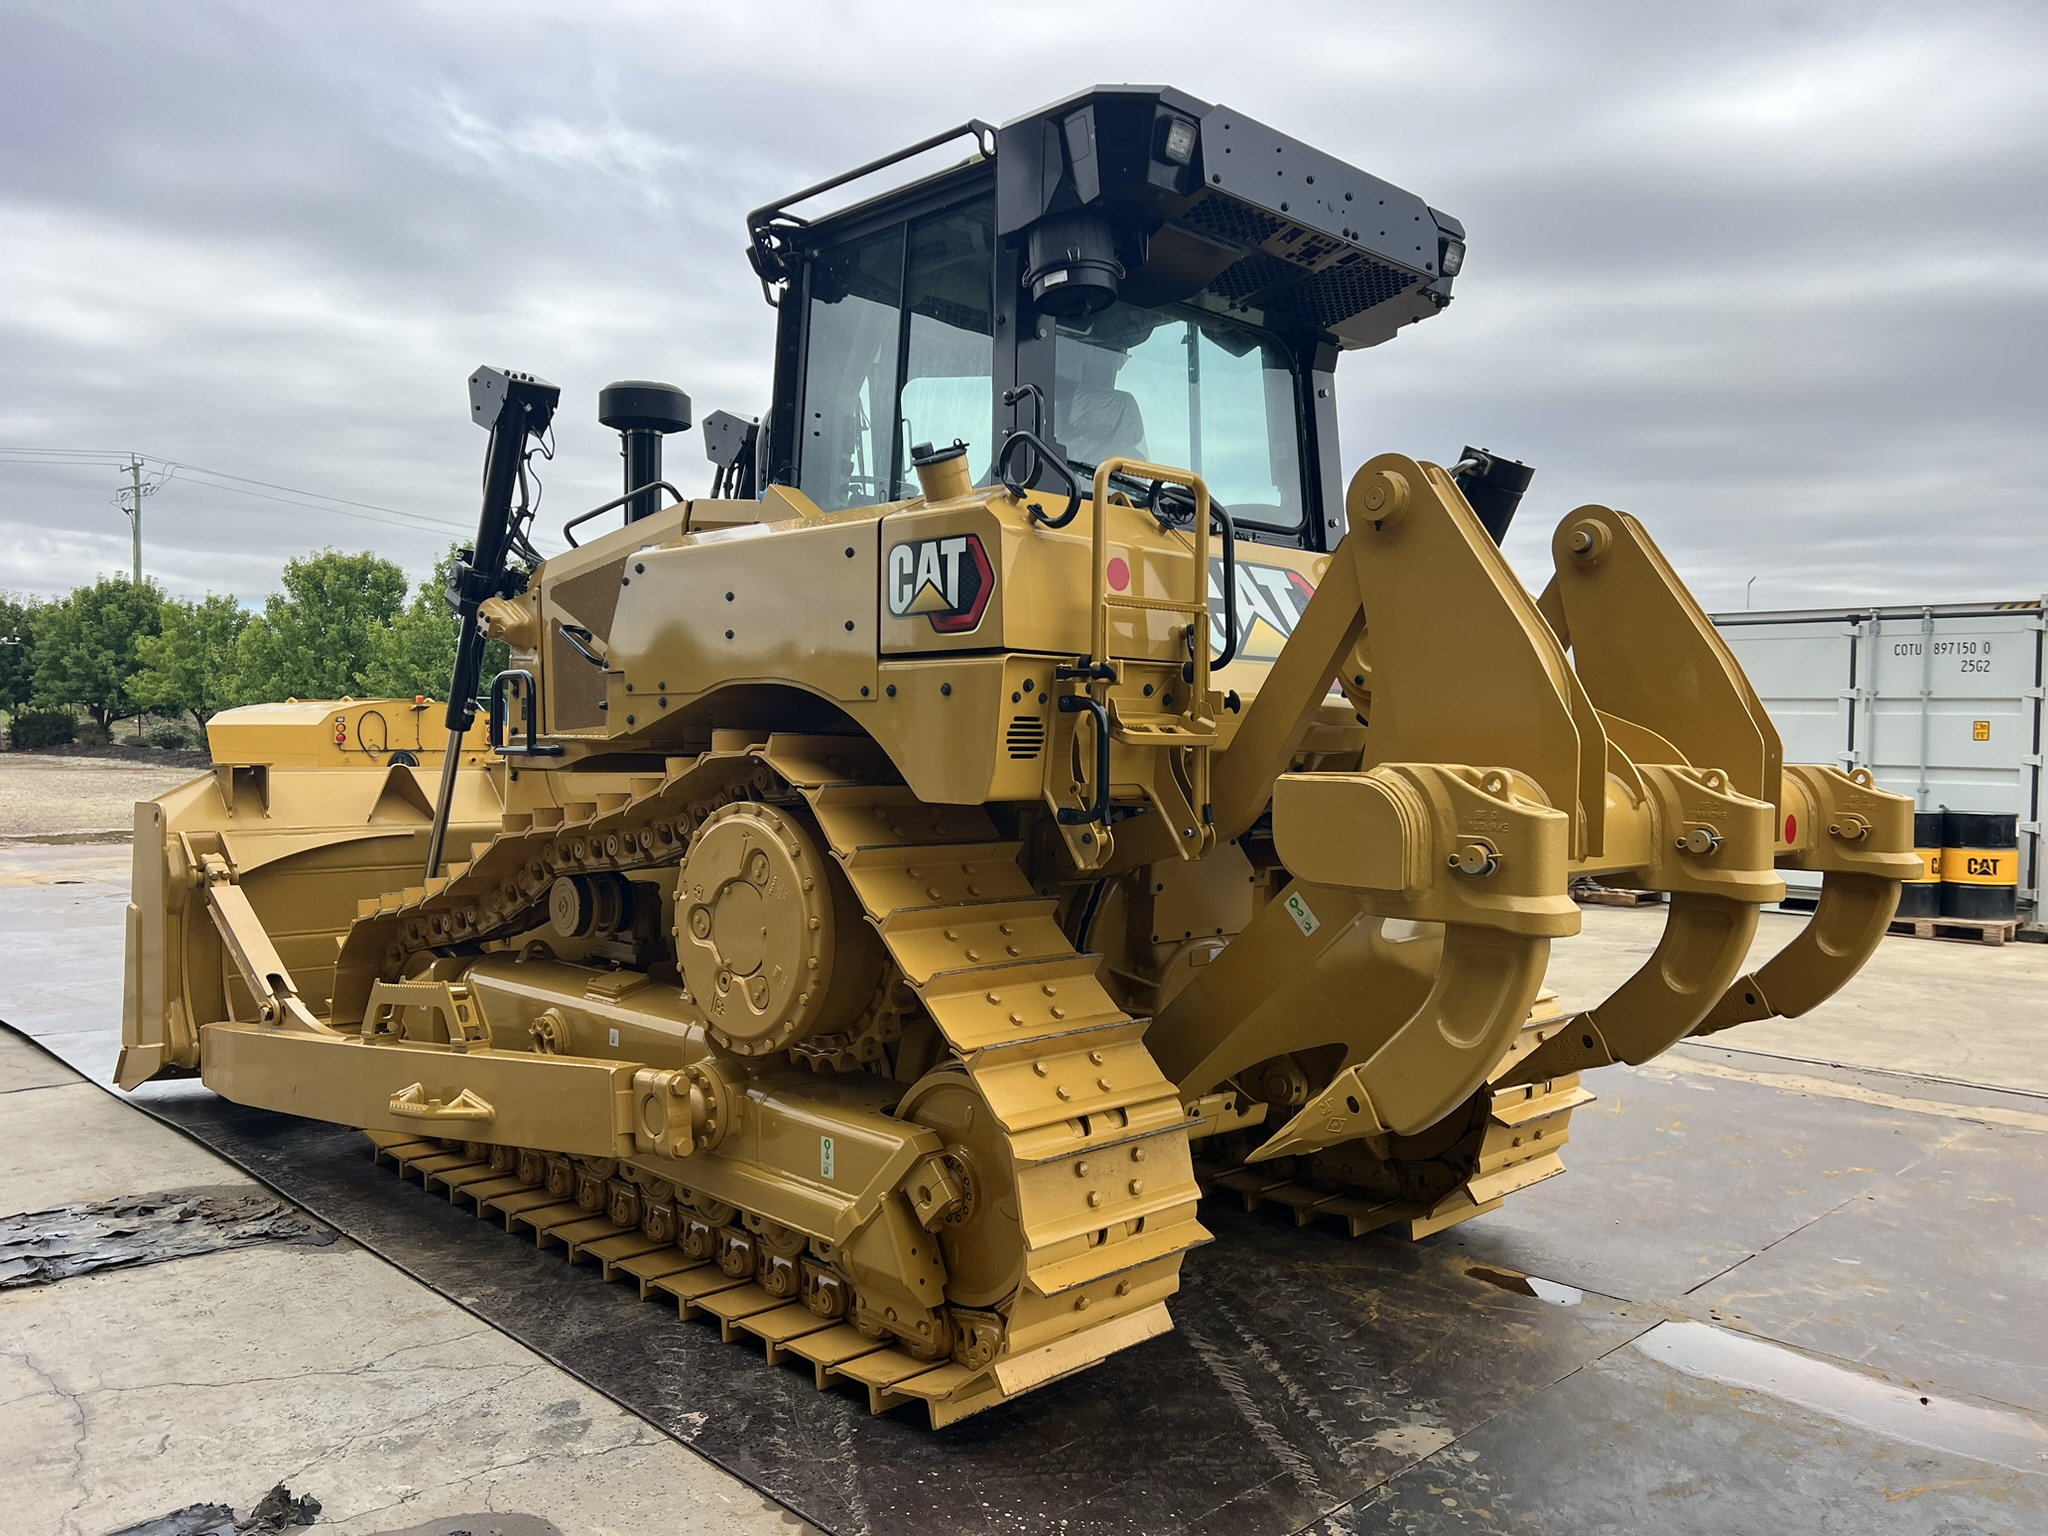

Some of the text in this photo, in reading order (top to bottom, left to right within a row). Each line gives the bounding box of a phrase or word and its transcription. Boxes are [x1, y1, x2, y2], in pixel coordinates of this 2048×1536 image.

[889, 537, 967, 614] CAT
[1893, 643, 1922, 656] COTU
[1933, 641, 1977, 655] 897150
[1961, 660, 1991, 673] 25G2
[1967, 857, 2000, 876] CAT
